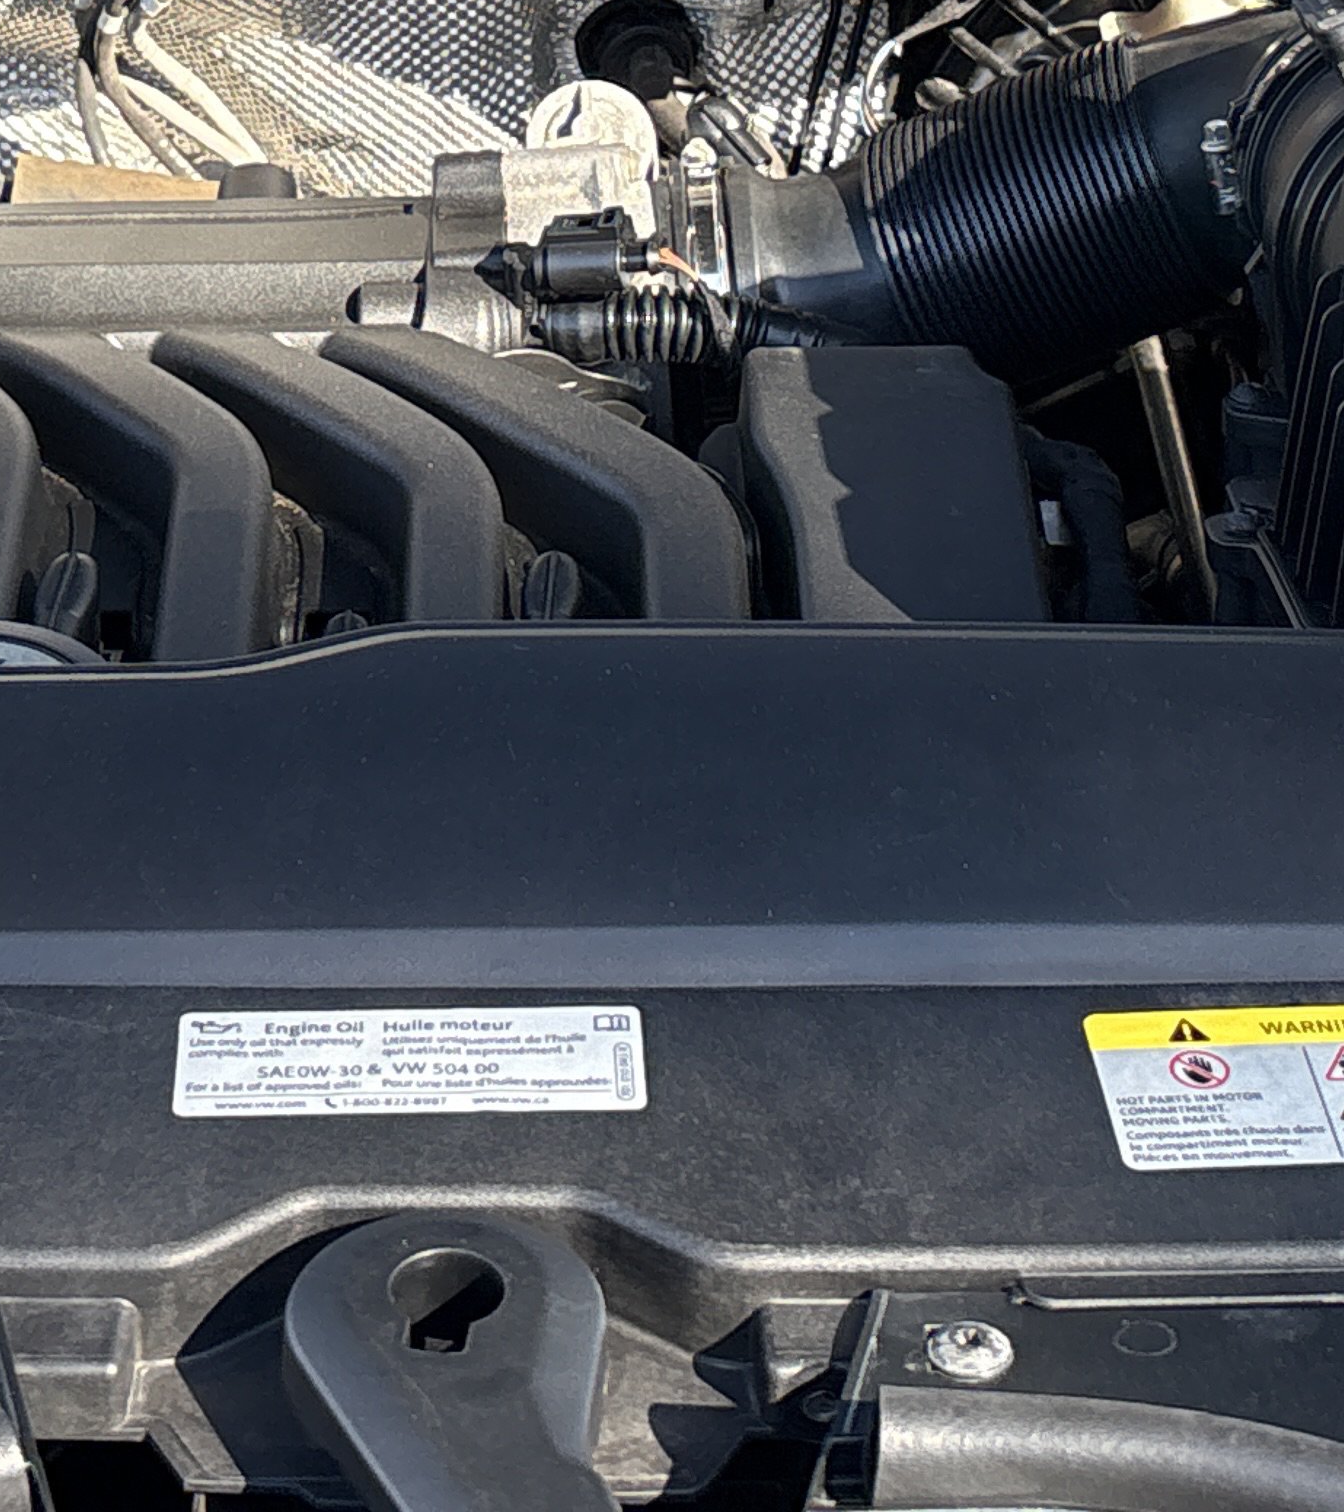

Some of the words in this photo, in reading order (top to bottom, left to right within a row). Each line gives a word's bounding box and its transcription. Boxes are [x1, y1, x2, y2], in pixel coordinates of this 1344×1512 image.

[264, 1021, 332, 1037] Engine
[336, 1021, 365, 1033] Oil
[382, 1019, 435, 1032] Huile
[440, 1019, 514, 1031] moteur
[269, 1037, 297, 1046] that
[300, 1037, 364, 1048] expressly
[436, 1035, 521, 1046] uniquement
[525, 1034, 542, 1044] de
[252, 1049, 285, 1058] with
[367, 1063, 382, 1075] &
[391, 1062, 427, 1075] VW
[432, 1062, 469, 1075] 504
[474, 1062, 500, 1074] 00
[265, 1080, 331, 1093] approved
[1115, 1095, 1145, 1106] HOT
[1148, 1094, 1192, 1105] PARTS
[1194, 1093, 1209, 1103] IN
[1212, 1092, 1264, 1102] MOTOR
[1121, 1116, 1180, 1127] MOVING
[1126, 1128, 1212, 1141] Composants
[1242, 1125, 1290, 1135] chauds
[1292, 1123, 1326, 1134] dans
[1146, 1139, 1248, 1151] compartiment
[1181, 1152, 1200, 1161] en
